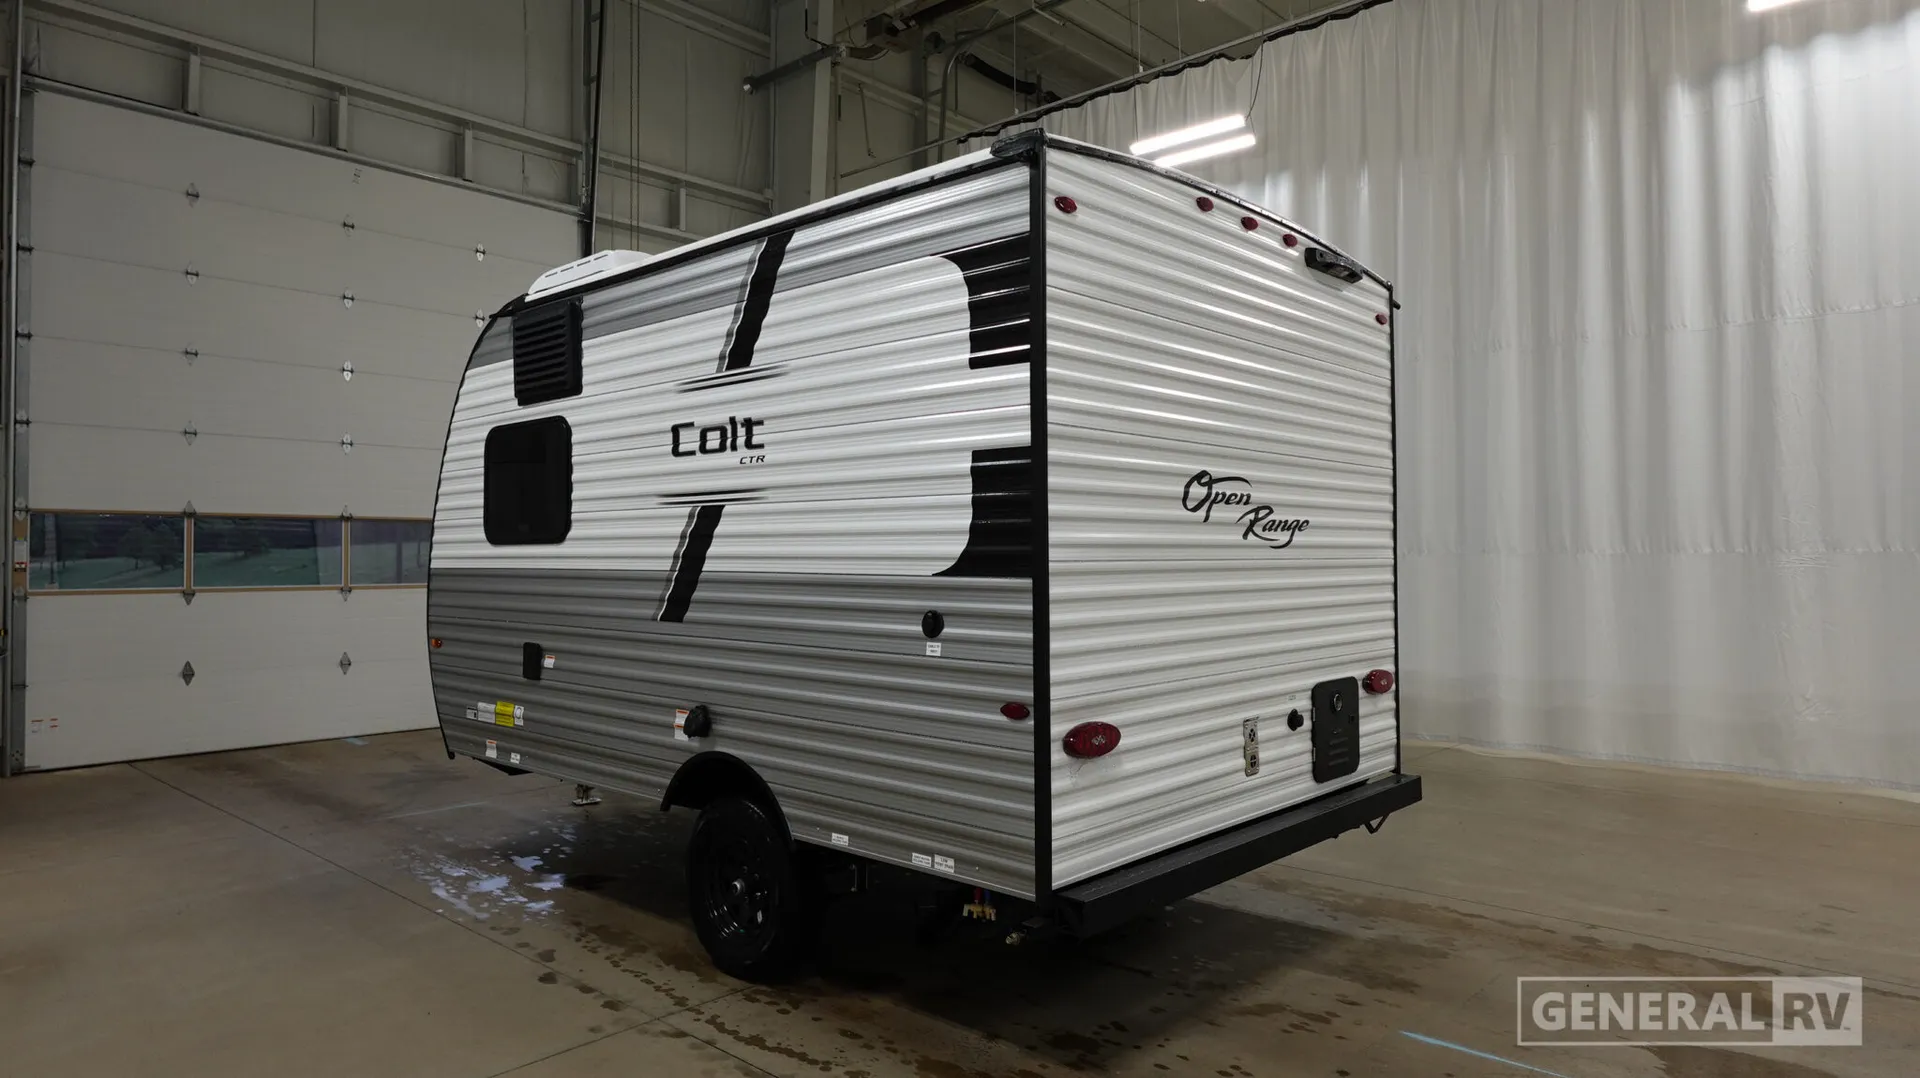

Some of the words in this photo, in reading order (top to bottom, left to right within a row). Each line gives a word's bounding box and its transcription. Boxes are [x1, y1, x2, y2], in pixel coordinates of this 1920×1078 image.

[671, 416, 765, 457] Colt
[739, 455, 766, 465] CTR
[1182, 470, 1253, 522] Open
[1235, 505, 1310, 549] Range
